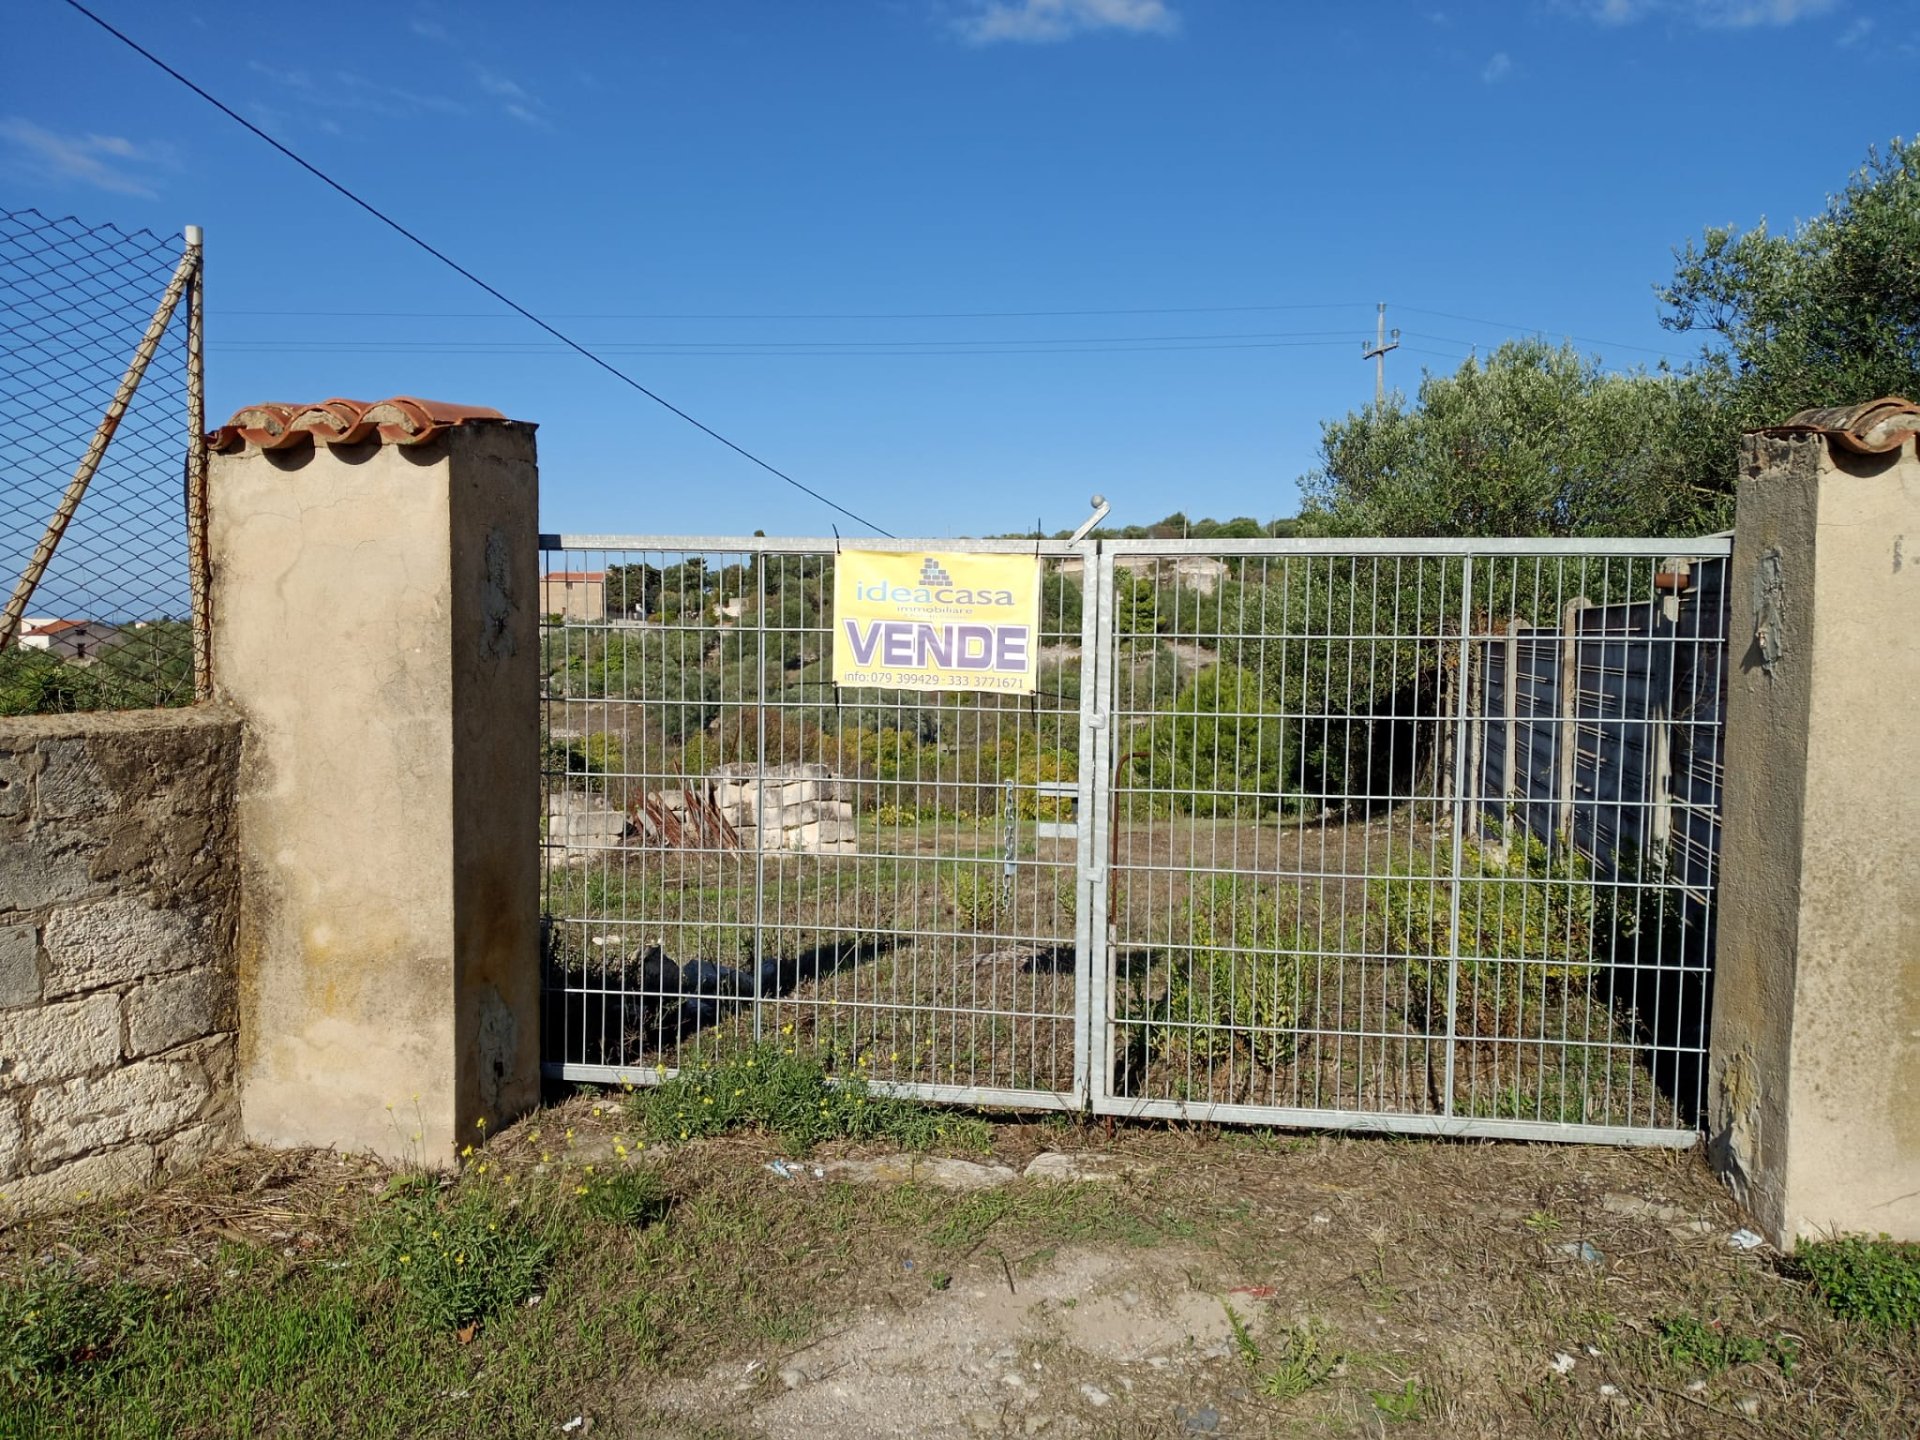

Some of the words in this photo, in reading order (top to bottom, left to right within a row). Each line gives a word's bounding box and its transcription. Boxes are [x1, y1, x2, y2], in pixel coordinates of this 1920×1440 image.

[897, 605, 973, 614] immobiliare
[844, 620, 1028, 671] VENDE
[897, 674, 939, 685] 399429
[949, 675, 969, 686] 333
[974, 676, 1023, 689] 3771671
